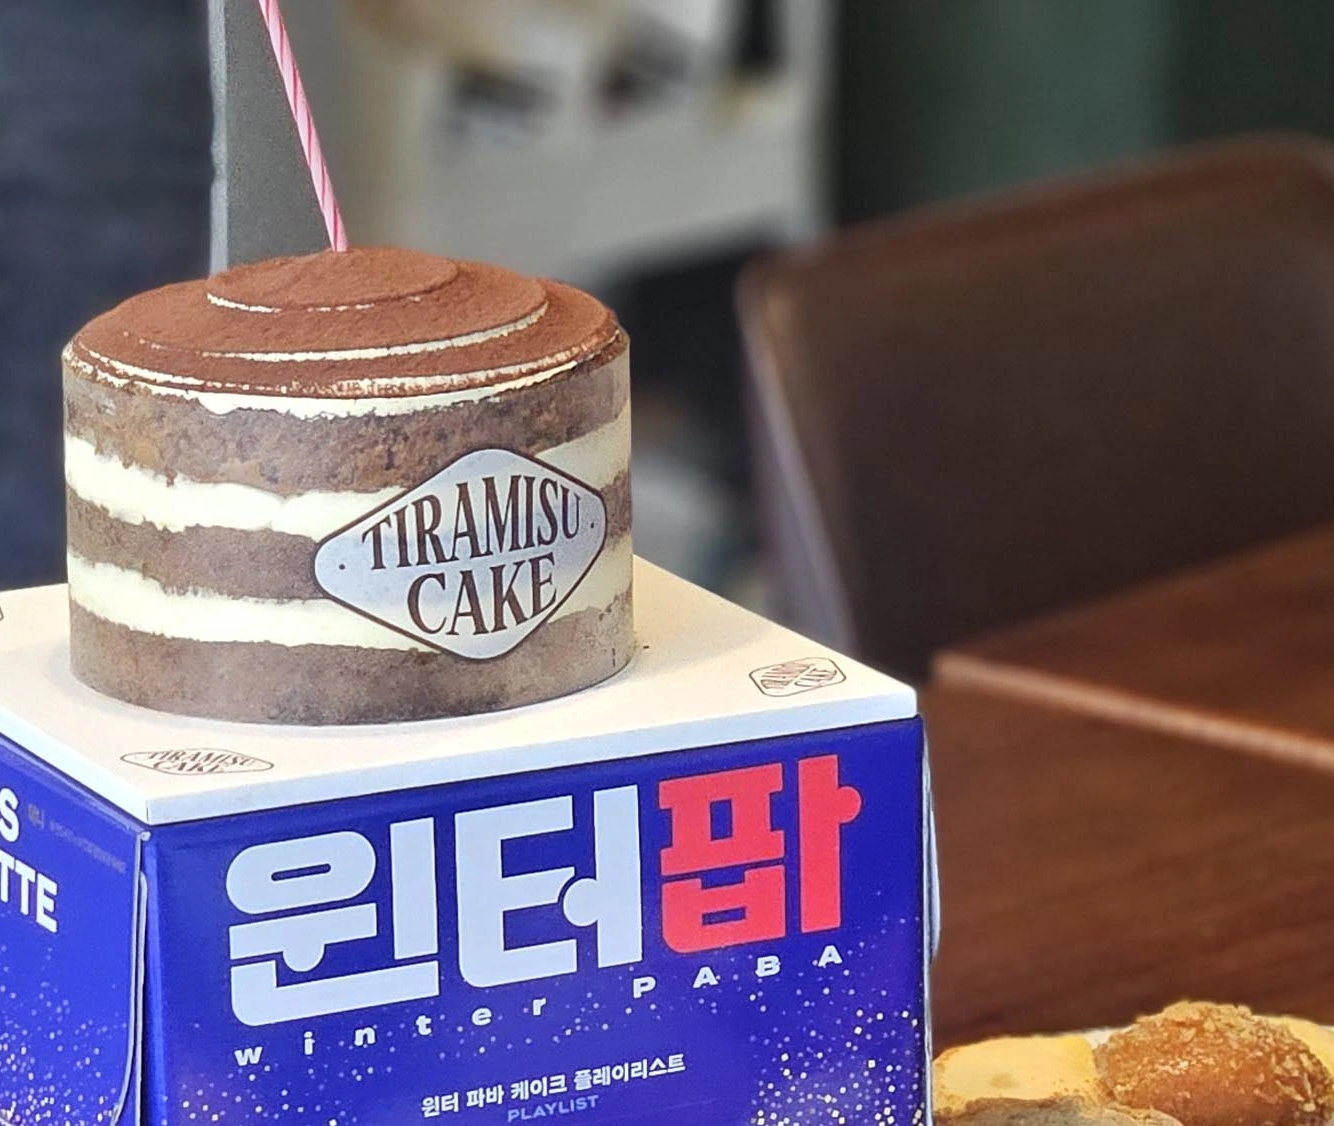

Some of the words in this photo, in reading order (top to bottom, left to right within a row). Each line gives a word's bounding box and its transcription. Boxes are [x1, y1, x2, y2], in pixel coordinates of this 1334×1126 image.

[361, 474, 582, 571] TIRAMISU
[407, 552, 557, 636] CAKE
[225, 753, 862, 1027] 윈터팝
[233, 996, 548, 1068] winter
[632, 944, 844, 1000] PABA
[421, 1091, 460, 1118] 윈터
[466, 1085, 505, 1109] 파바
[510, 1074, 568, 1101] 케이크
[573, 1053, 687, 1091] 플레이리스트
[506, 1094, 600, 1123] PLAYLIST
